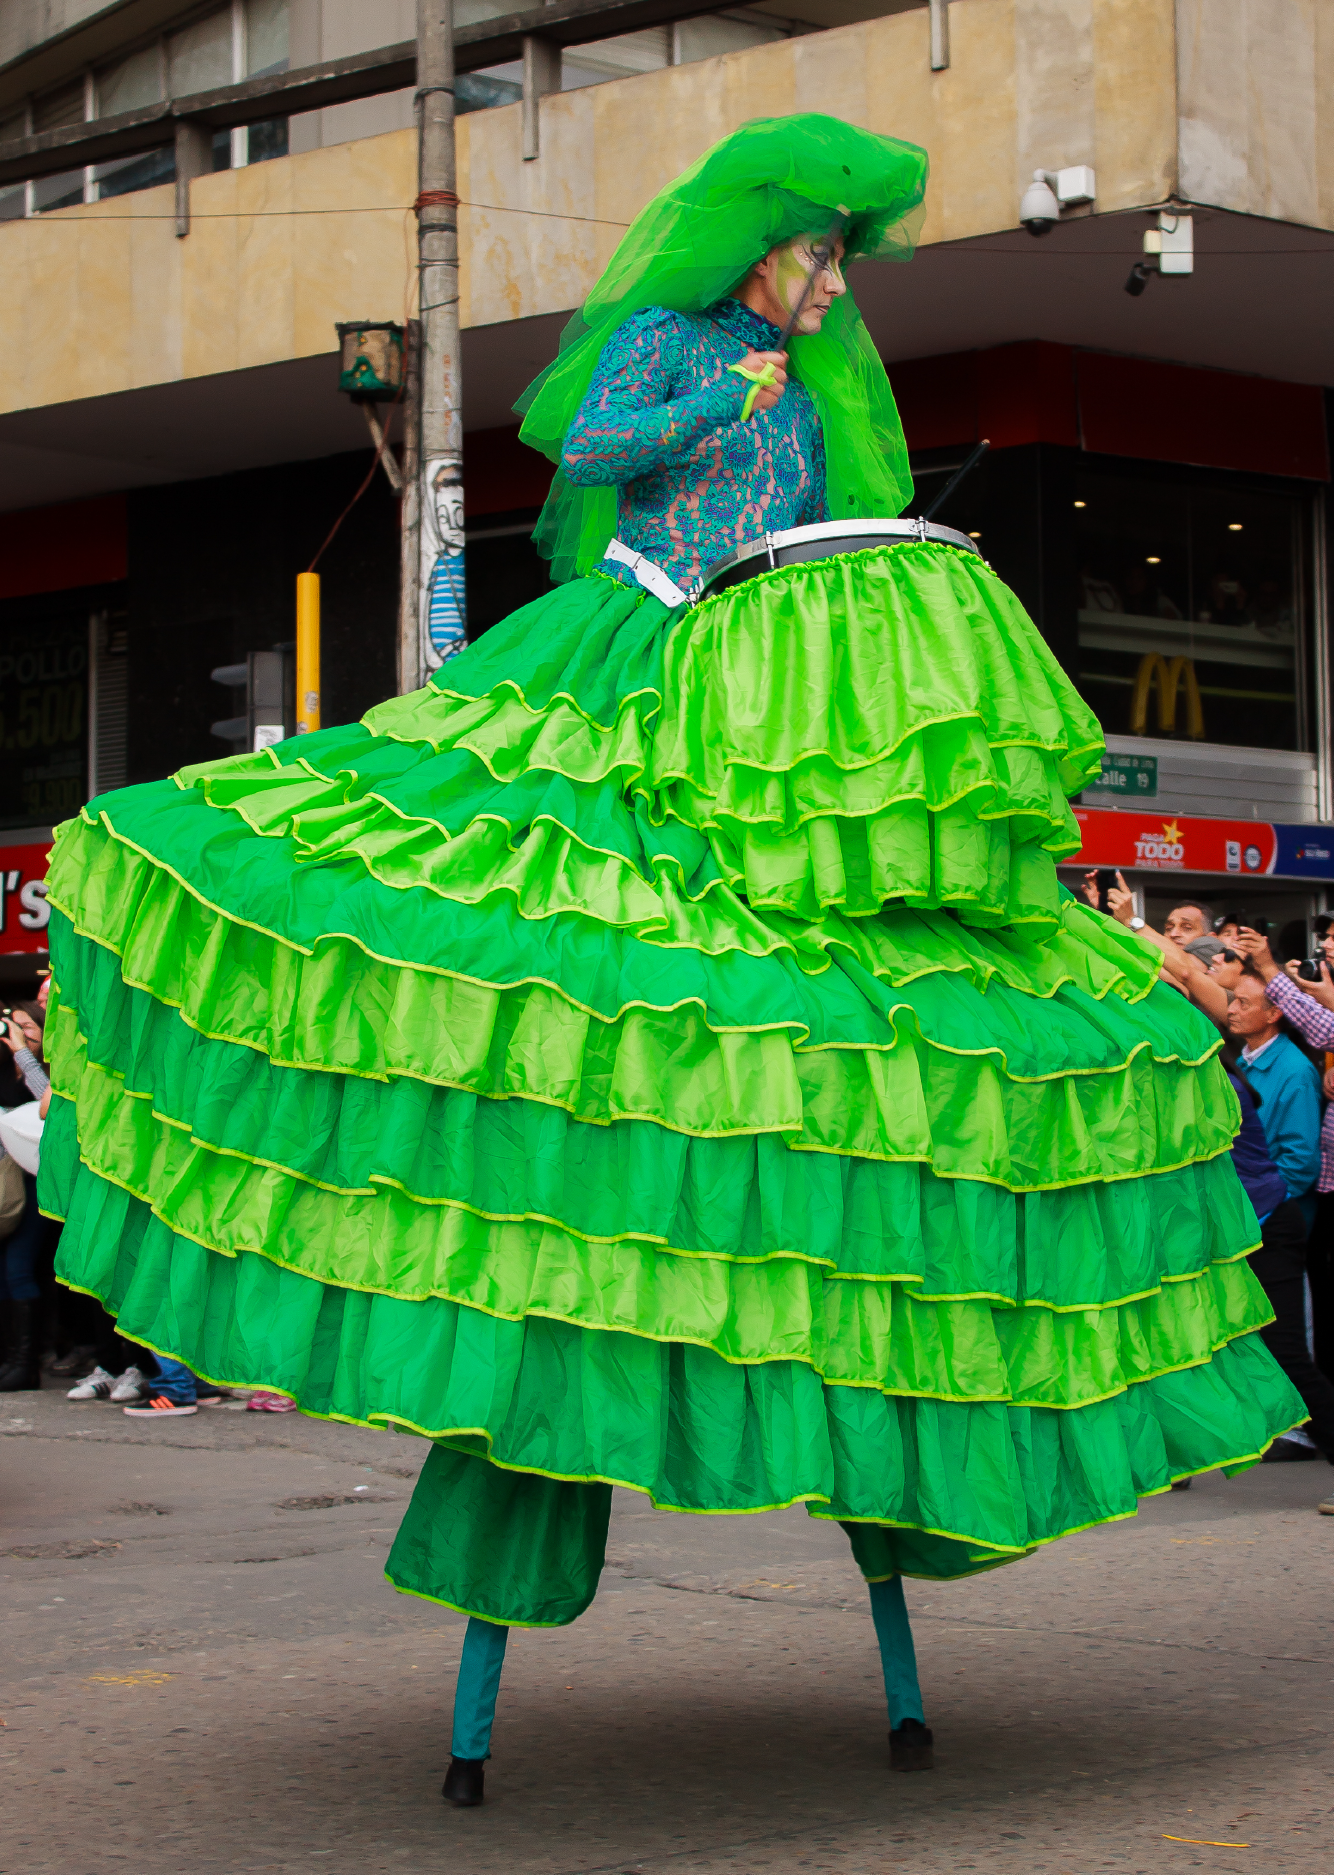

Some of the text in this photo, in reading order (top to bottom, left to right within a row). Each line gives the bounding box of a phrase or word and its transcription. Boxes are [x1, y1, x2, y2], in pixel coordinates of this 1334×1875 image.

[0, 681, 83, 749] .500
[1133, 841, 1184, 860] TODO
[0, 870, 52, 932] 's
